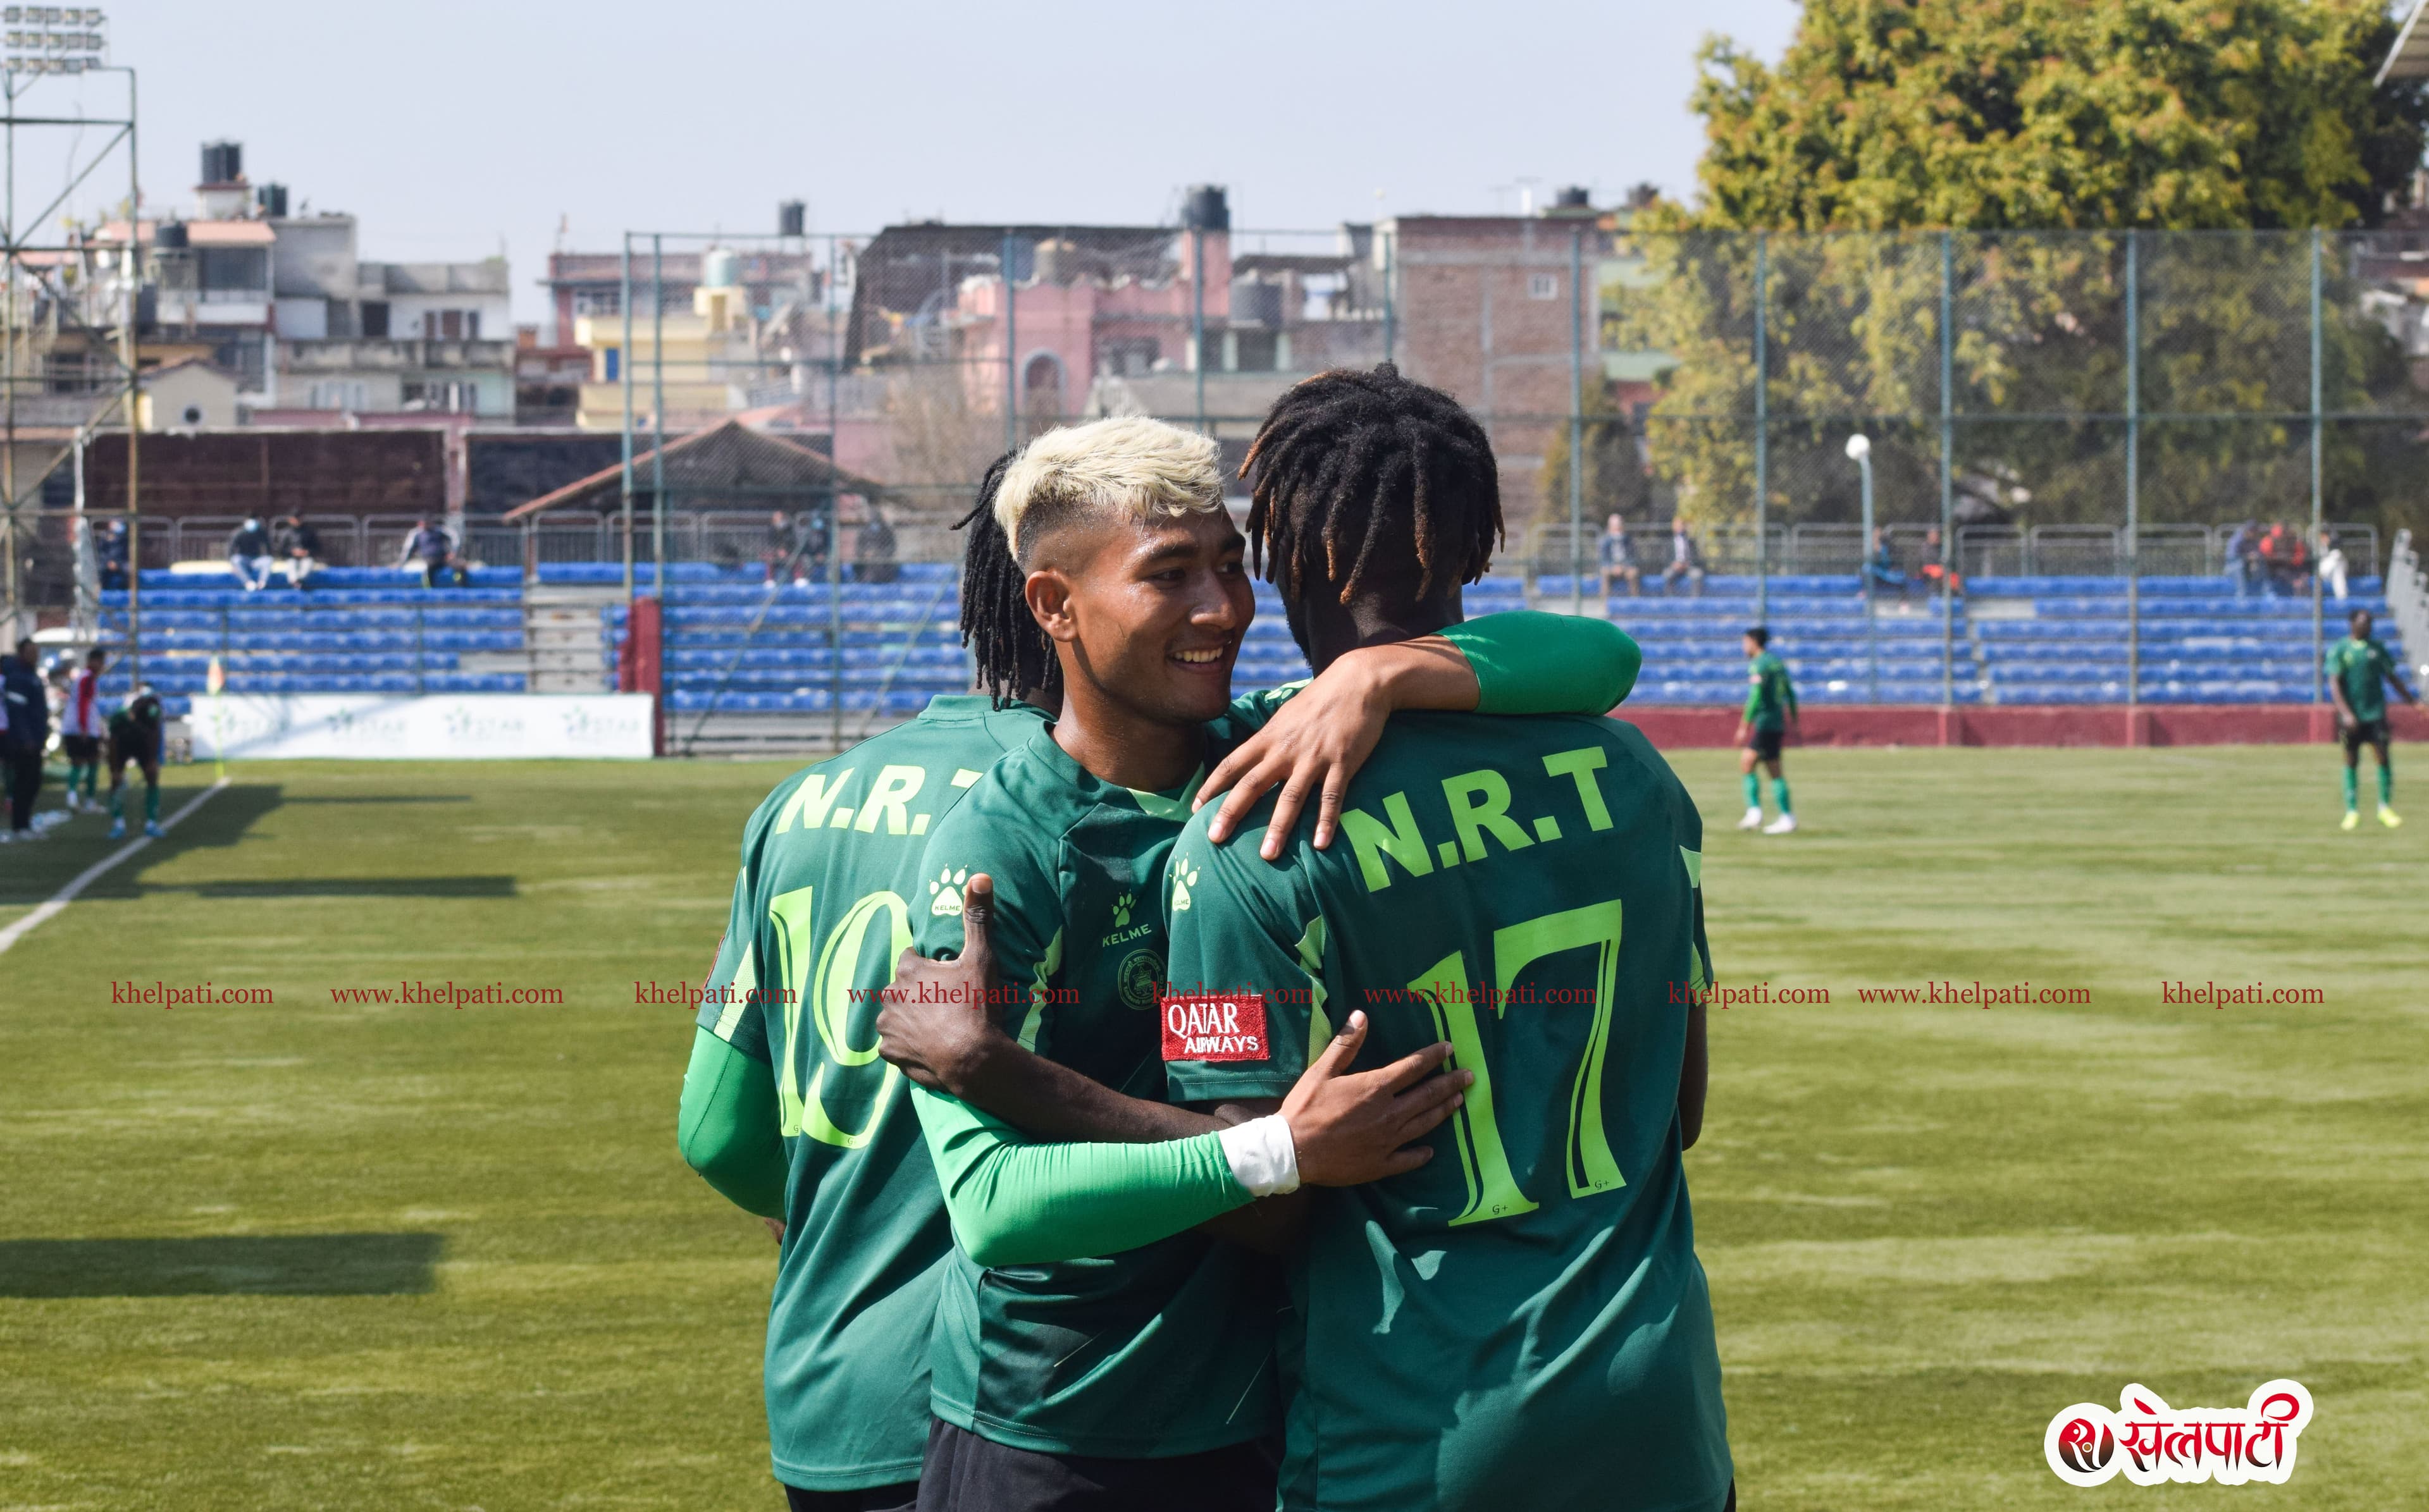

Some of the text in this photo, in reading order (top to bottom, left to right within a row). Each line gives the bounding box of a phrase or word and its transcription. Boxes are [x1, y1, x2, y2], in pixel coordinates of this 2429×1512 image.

[1339, 745, 1615, 894] N.R.T
[1102, 923, 1153, 948] KELME
[769, 885, 913, 1150] 19
[1168, 1002, 1240, 1038] QATAR
[1184, 1035, 1260, 1054] AIRWAYS
[1407, 899, 1628, 1227] 17
